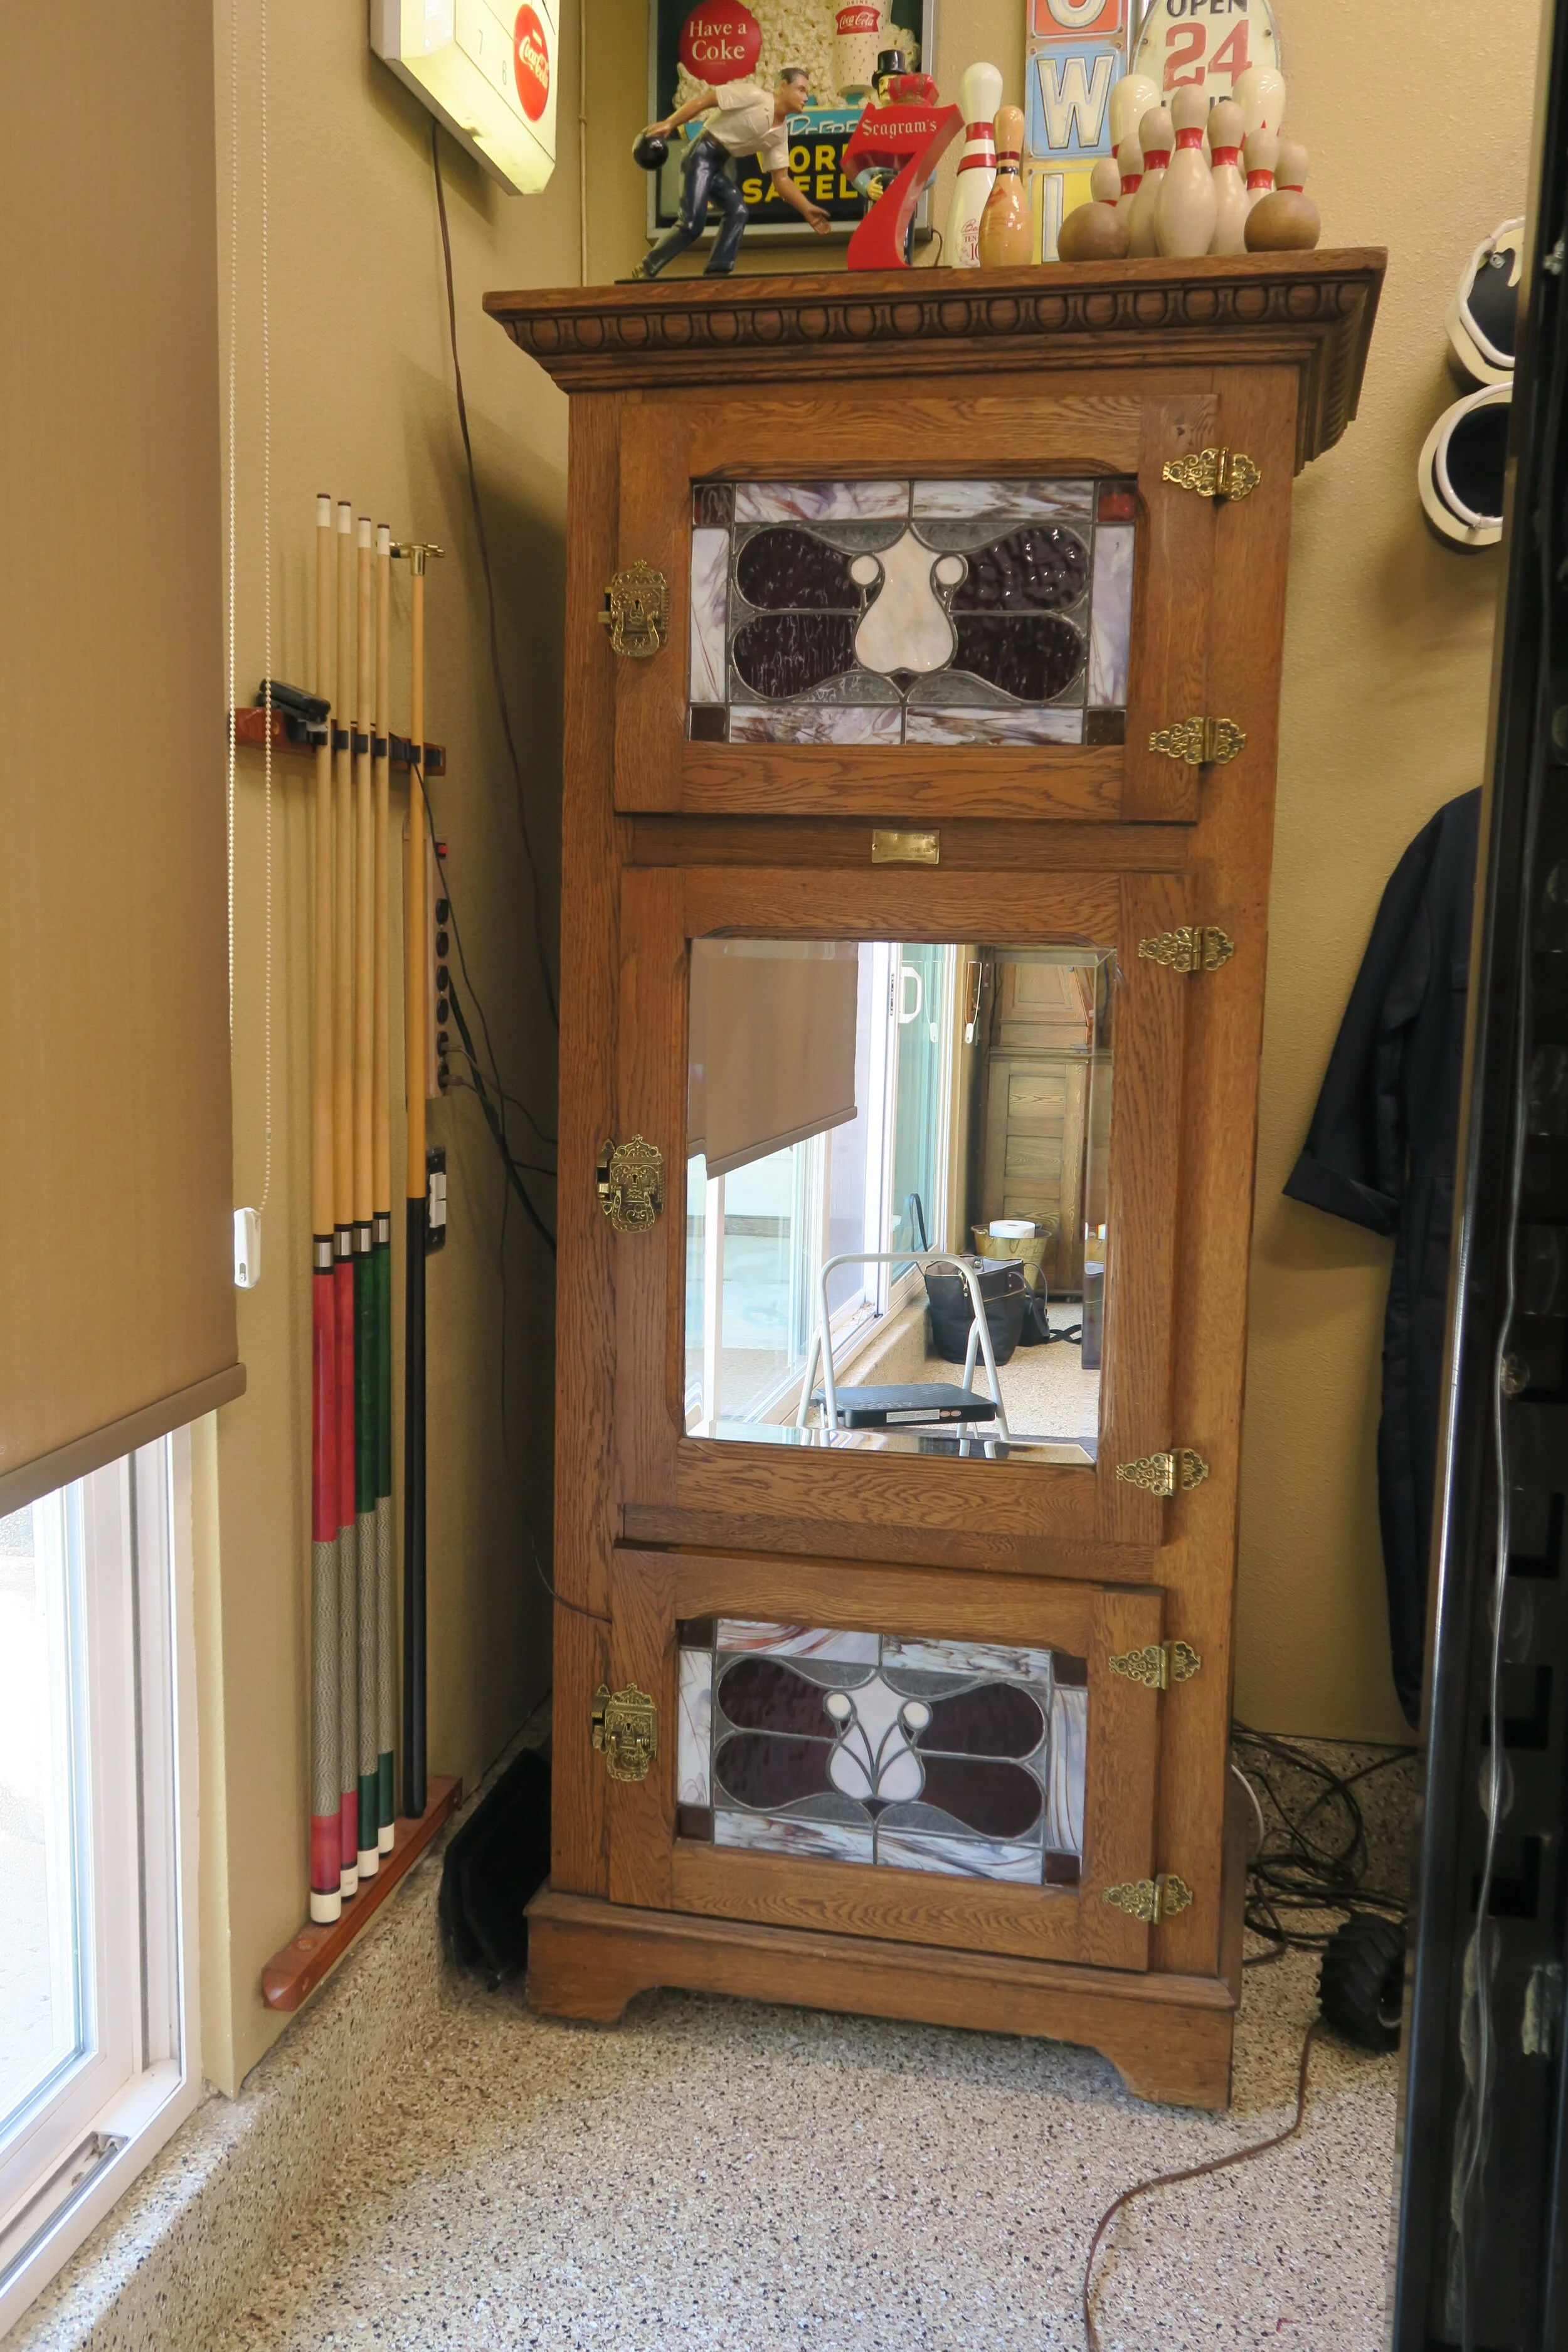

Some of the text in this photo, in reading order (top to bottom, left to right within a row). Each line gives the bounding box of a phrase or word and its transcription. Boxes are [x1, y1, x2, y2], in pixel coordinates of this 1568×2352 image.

[689, 20, 748, 38] Have a
[692, 39, 745, 61] Coke
[1163, 19, 1253, 92] 24
[862, 119, 937, 139] Seagram's
